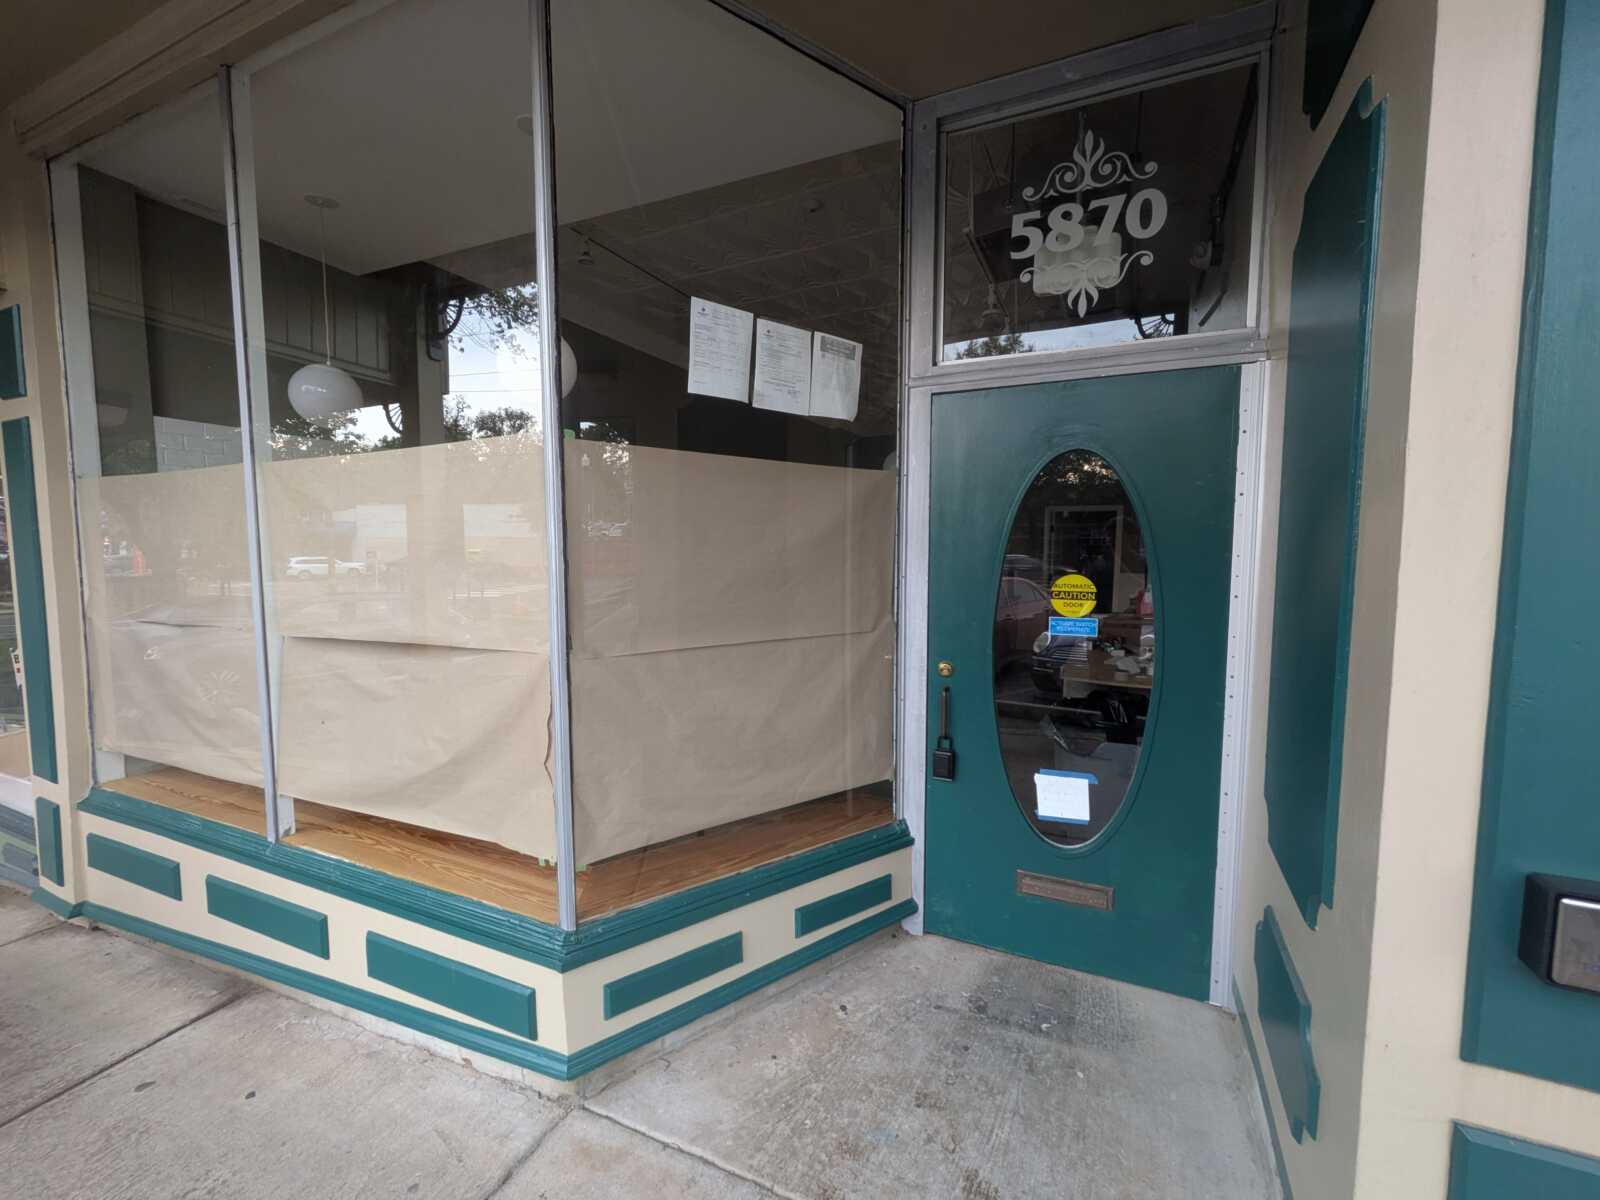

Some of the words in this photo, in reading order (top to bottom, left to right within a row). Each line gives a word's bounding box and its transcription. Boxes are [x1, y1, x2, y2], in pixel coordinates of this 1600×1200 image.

[1010, 188, 1168, 260] 5870
[1053, 583, 1096, 591] AUTOMATIC
[1052, 591, 1096, 600] CAUTION
